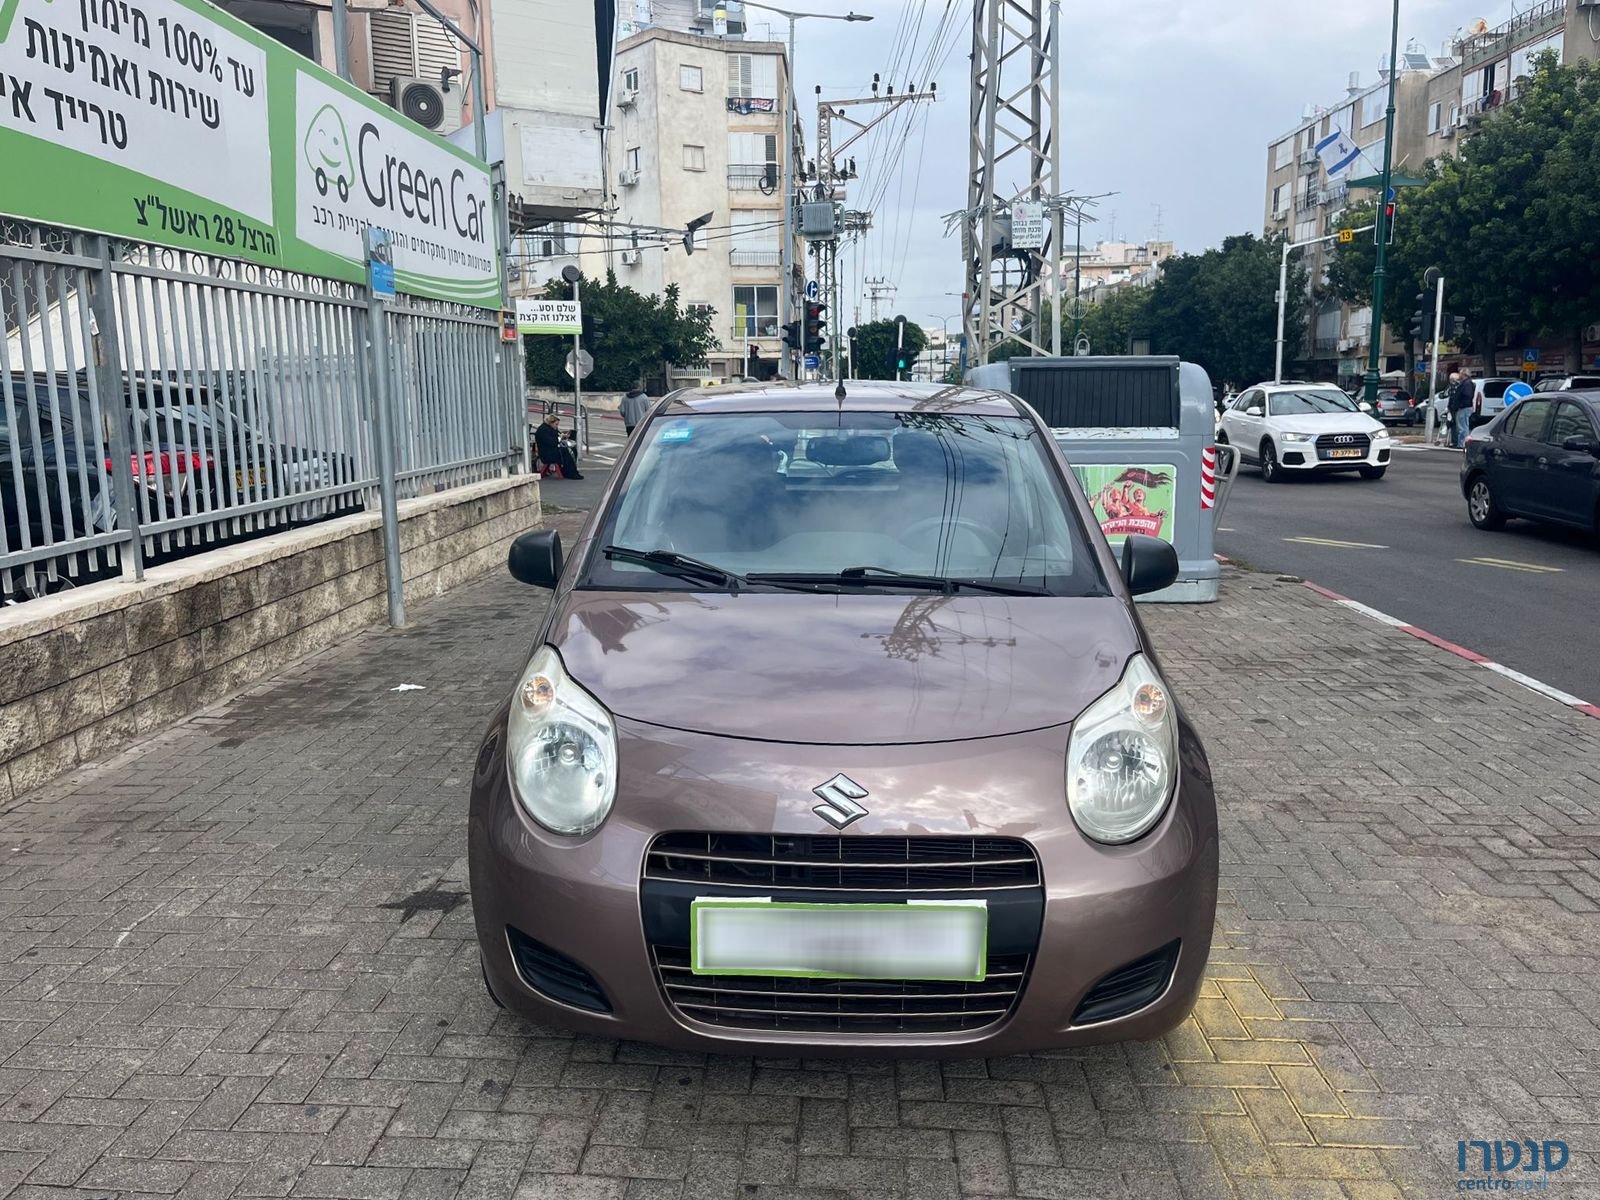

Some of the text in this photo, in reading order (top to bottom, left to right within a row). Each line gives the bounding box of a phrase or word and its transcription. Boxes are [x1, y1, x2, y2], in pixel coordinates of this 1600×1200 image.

[158, 17, 223, 83] 100%
[24, 17, 220, 129] שירות ואמינות
[227, 57, 255, 98] עד
[44, 87, 128, 150] טרייד
[358, 122, 486, 244] Green Car
[312, 204, 335, 228] רכב
[213, 214, 235, 246] 28
[237, 219, 276, 256] הרצל
[1341, 231, 1351, 240] 13
[411, 236, 446, 261] מתקדמים
[447, 247, 466, 266] מימון
[467, 254, 492, 273] פתרונות
[519, 313, 577, 323] אצלנו זה קצת
[530, 303, 576, 312] שלם וסע...
[1128, 518, 1157, 530] מהפכת
